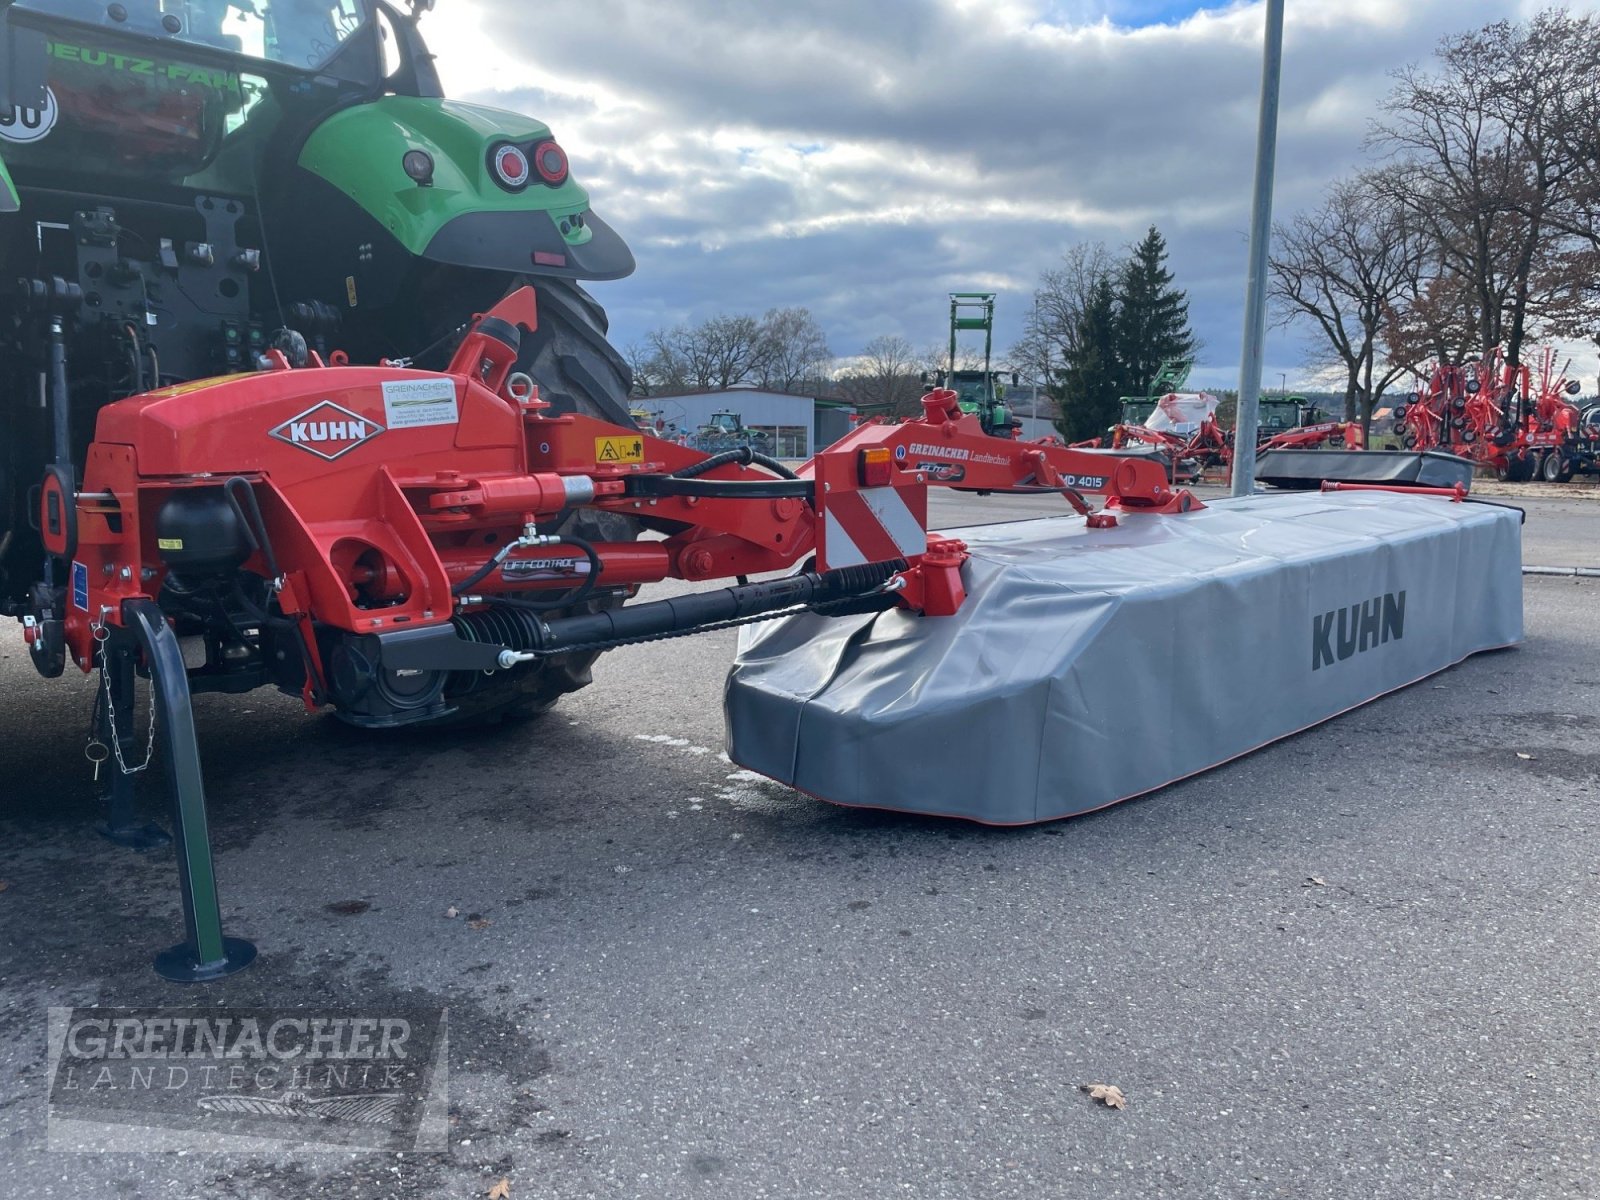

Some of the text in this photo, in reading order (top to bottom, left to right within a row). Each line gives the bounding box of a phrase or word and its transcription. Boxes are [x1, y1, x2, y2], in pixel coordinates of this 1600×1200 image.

[46, 41, 262, 98] EUTZ-FAHR
[385, 382, 449, 394] GREINACHER
[290, 421, 367, 442] KUHN
[908, 443, 1012, 466] GREINACHER Landtechnik
[1078, 476, 1103, 488] 4015
[1312, 590, 1406, 671] KUHN
